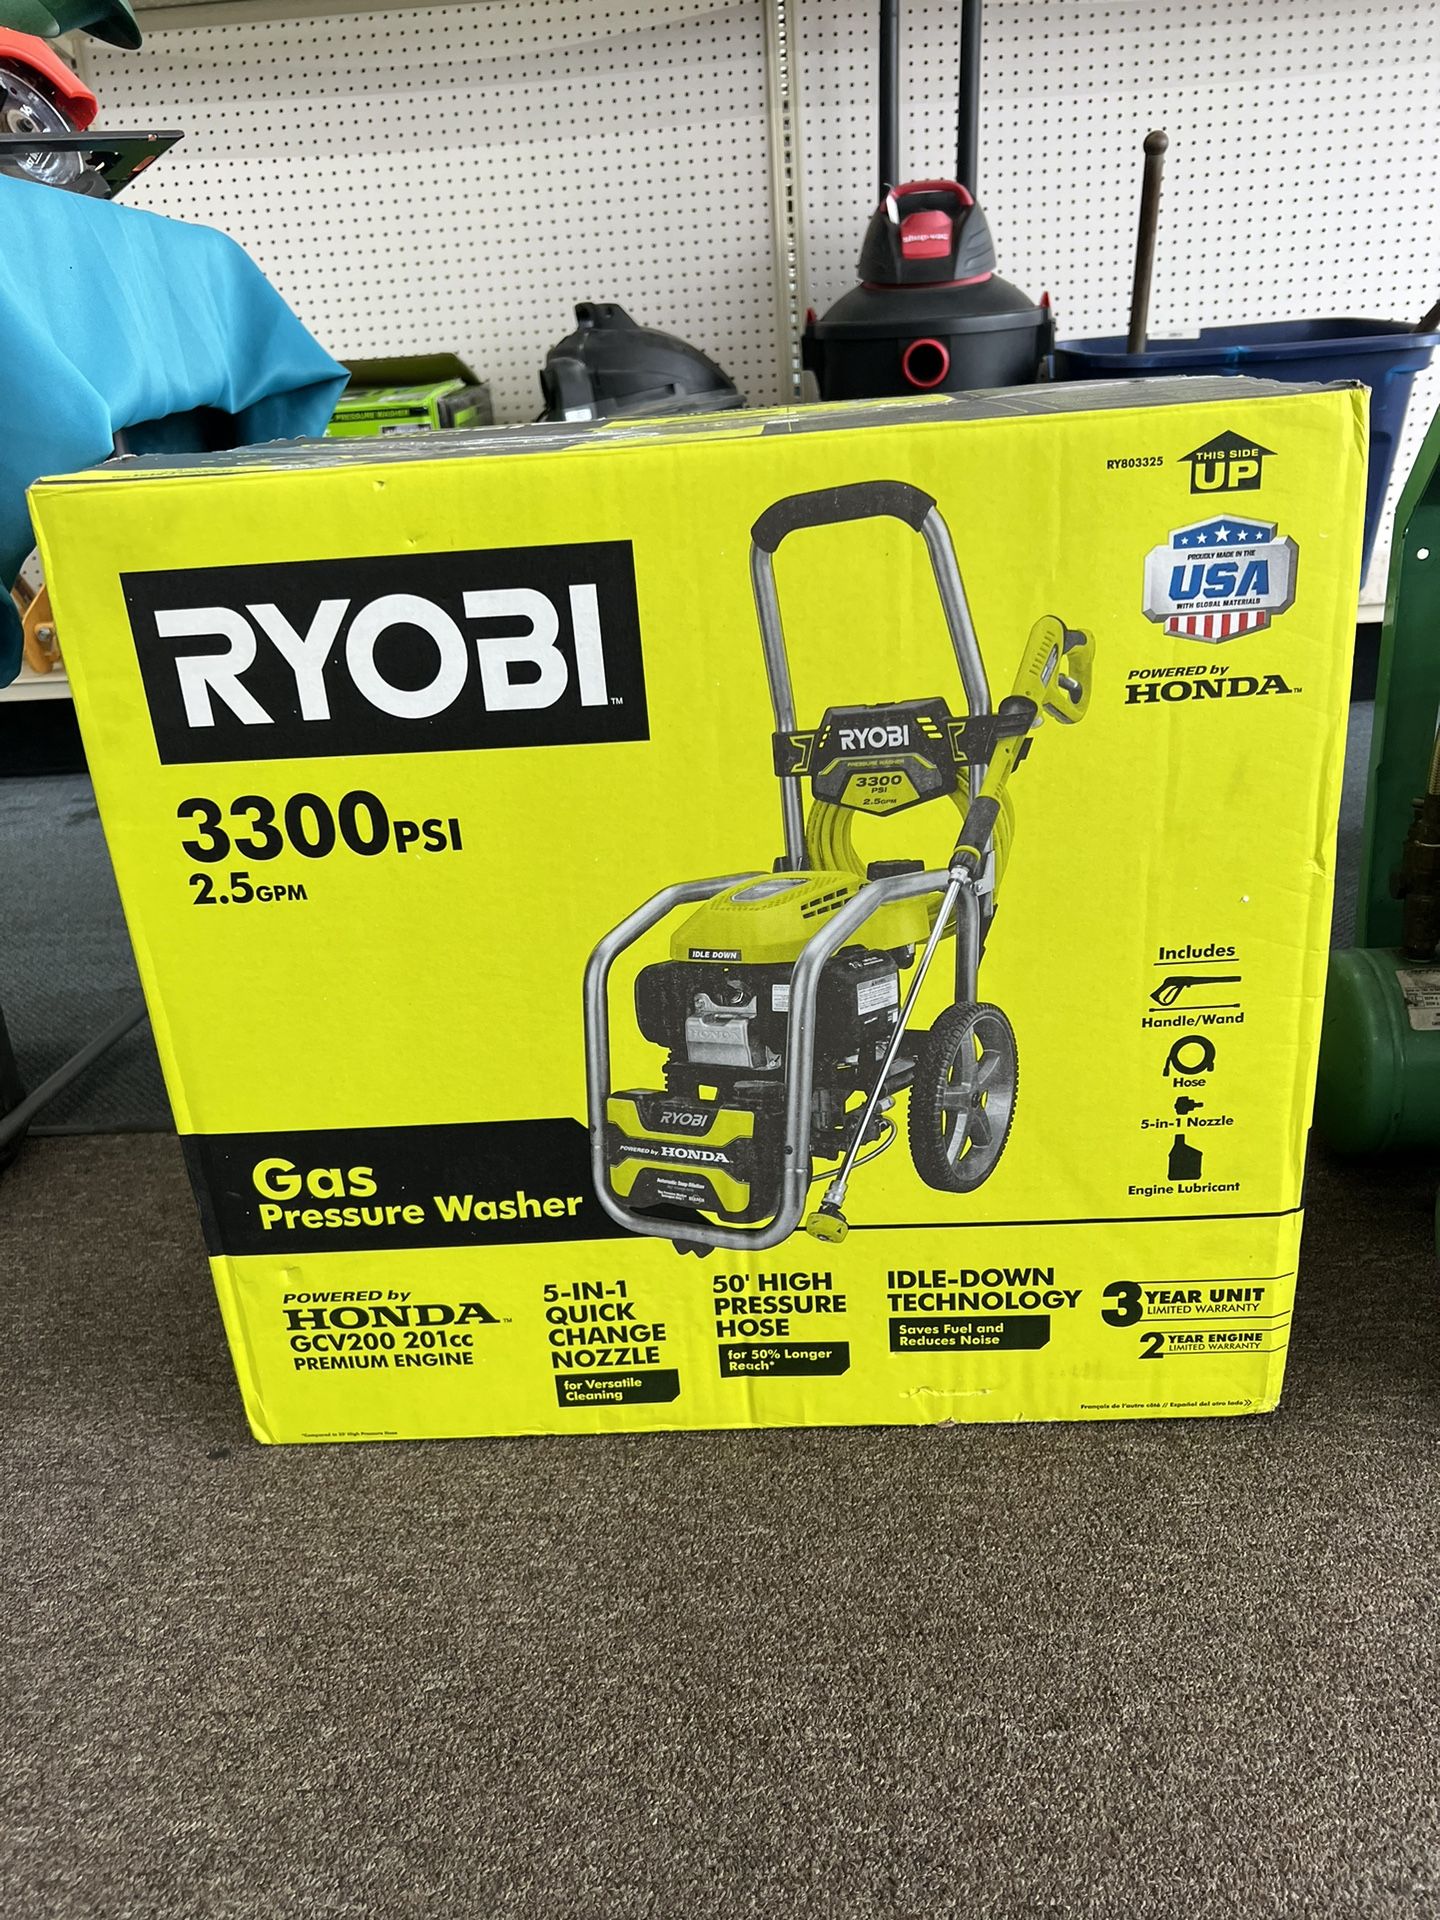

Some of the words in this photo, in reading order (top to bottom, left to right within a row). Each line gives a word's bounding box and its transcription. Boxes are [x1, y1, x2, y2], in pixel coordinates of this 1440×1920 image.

[1196, 451, 1224, 460] THIS
[1229, 449, 1259, 458] SIDE
[1107, 457, 1163, 470] RY803325
[1194, 460, 1259, 490] UP
[1187, 552, 1214, 560] PROUDLY
[1216, 551, 1234, 559] MADE
[1169, 560, 1269, 600] USA
[1196, 600, 1220, 608] GLOBAL
[1223, 598, 1260, 606] MATERIALS
[154, 584, 608, 728] RYOBI
[1128, 666, 1206, 680] POWERED
[1210, 665, 1229, 676] by
[839, 725, 909, 750] RYOBI
[856, 775, 902, 787] 3300
[1159, 944, 1236, 960] Includes
[1142, 1012, 1244, 1028] Handle/Wand
[1173, 1078, 1206, 1087] Hose
[660, 1111, 708, 1127] RYOBI
[1141, 1118, 1181, 1129] 5-in-1
[1187, 1116, 1233, 1127] Nozzle
[620, 1146, 650, 1154] POWERED
[252, 1157, 377, 1200] Gas
[1128, 1184, 1173, 1197] Engine
[1178, 1182, 1240, 1193] Lubricant
[260, 1204, 424, 1231] Pressure
[433, 1191, 583, 1225] Washer
[712, 1274, 750, 1293] 50'
[758, 1272, 833, 1292] HIGH
[887, 1268, 1055, 1289] IDLE-DOWN
[283, 1291, 383, 1304] POWERED
[388, 1289, 411, 1302] by
[544, 1280, 628, 1301] 5-IN-1
[714, 1295, 847, 1316] PRESSURE
[887, 1290, 1082, 1312] TECHNOLOGY
[1101, 1281, 1143, 1327] 3
[1145, 1290, 1202, 1304] YEAR
[1210, 1288, 1264, 1302] UNIT
[546, 1302, 636, 1326] QUICK
[1148, 1305, 1191, 1315] LIMITED
[1196, 1304, 1259, 1313] WARRANTY
[548, 1323, 667, 1347] CHANGE
[716, 1319, 789, 1338] HOSE
[899, 1325, 939, 1334] Saves
[944, 1324, 971, 1334] Fuel
[977, 1323, 1004, 1334] and
[290, 1332, 395, 1352] GCV200
[404, 1330, 474, 1348] 201cc
[900, 1336, 956, 1345] Reduces
[960, 1335, 1000, 1344] Noise
[1139, 1332, 1164, 1359] 2
[1168, 1335, 1203, 1343] YEAR
[1209, 1333, 1262, 1342] ENGINE
[294, 1353, 388, 1370] PREMIUM
[394, 1352, 474, 1367] ENGINE
[552, 1346, 660, 1369] NOZZLE
[728, 1350, 747, 1359] for
[750, 1349, 780, 1359] 50%
[784, 1349, 832, 1361] Longer
[564, 1380, 579, 1390] for
[585, 1377, 642, 1390] Versatile
[566, 1389, 623, 1401] Cleaning
